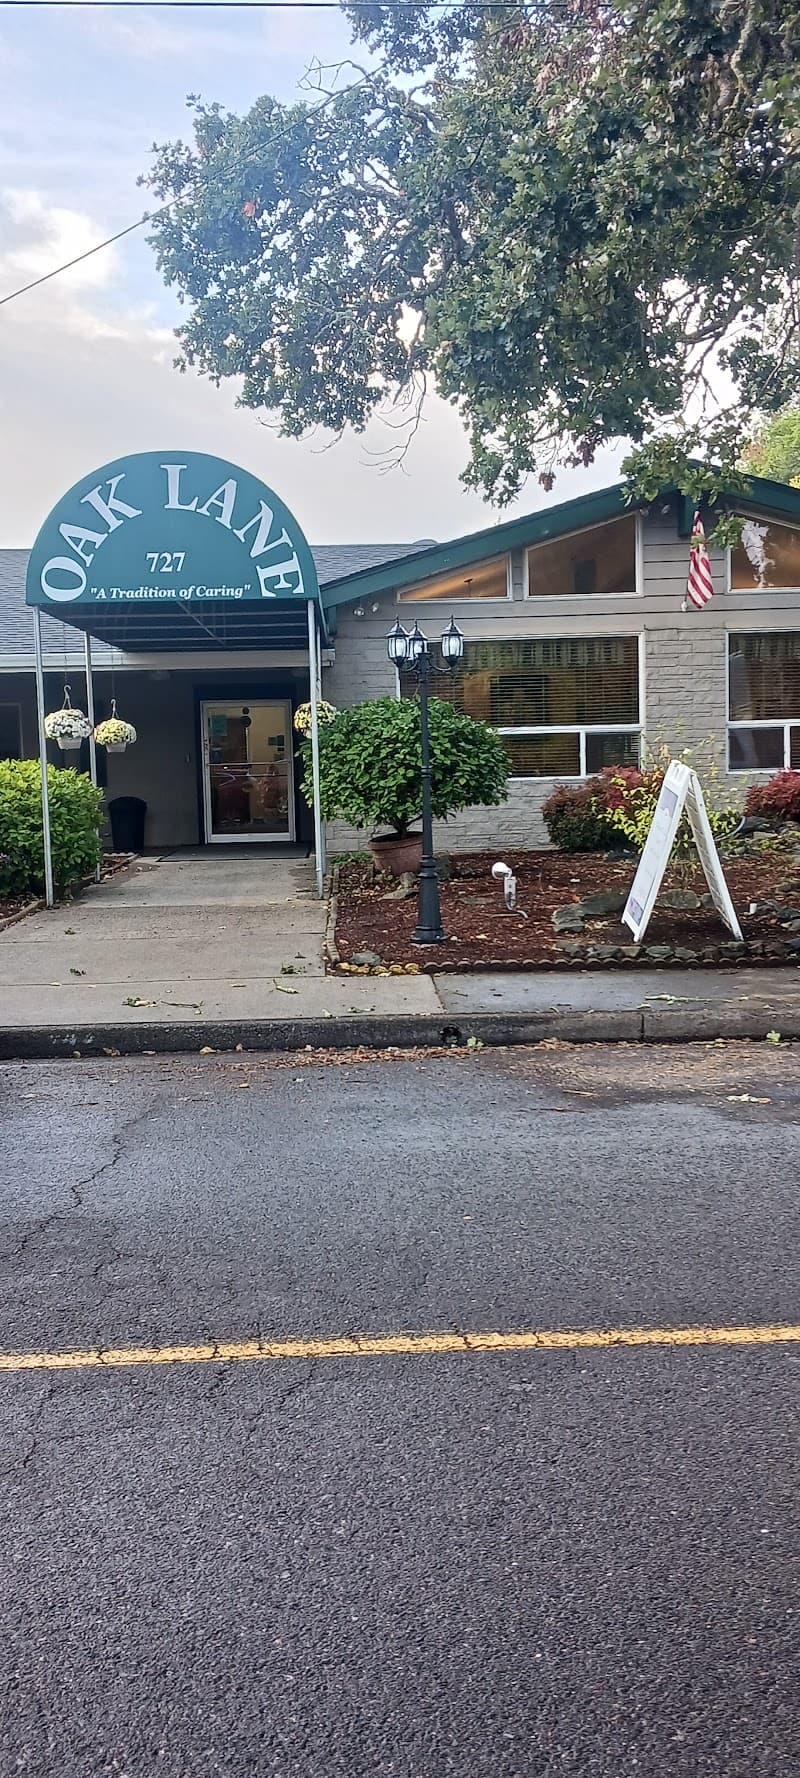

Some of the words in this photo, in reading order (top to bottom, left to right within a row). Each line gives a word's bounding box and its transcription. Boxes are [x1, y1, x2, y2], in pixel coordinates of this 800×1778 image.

[40, 473, 143, 602] OAK
[159, 464, 305, 598] LANE
[145, 551, 186, 573] 727
[90, 587, 107, 599] "A
[109, 587, 177, 599] Tradition
[179, 585, 196, 600] of
[196, 584, 251, 599] Caring"
